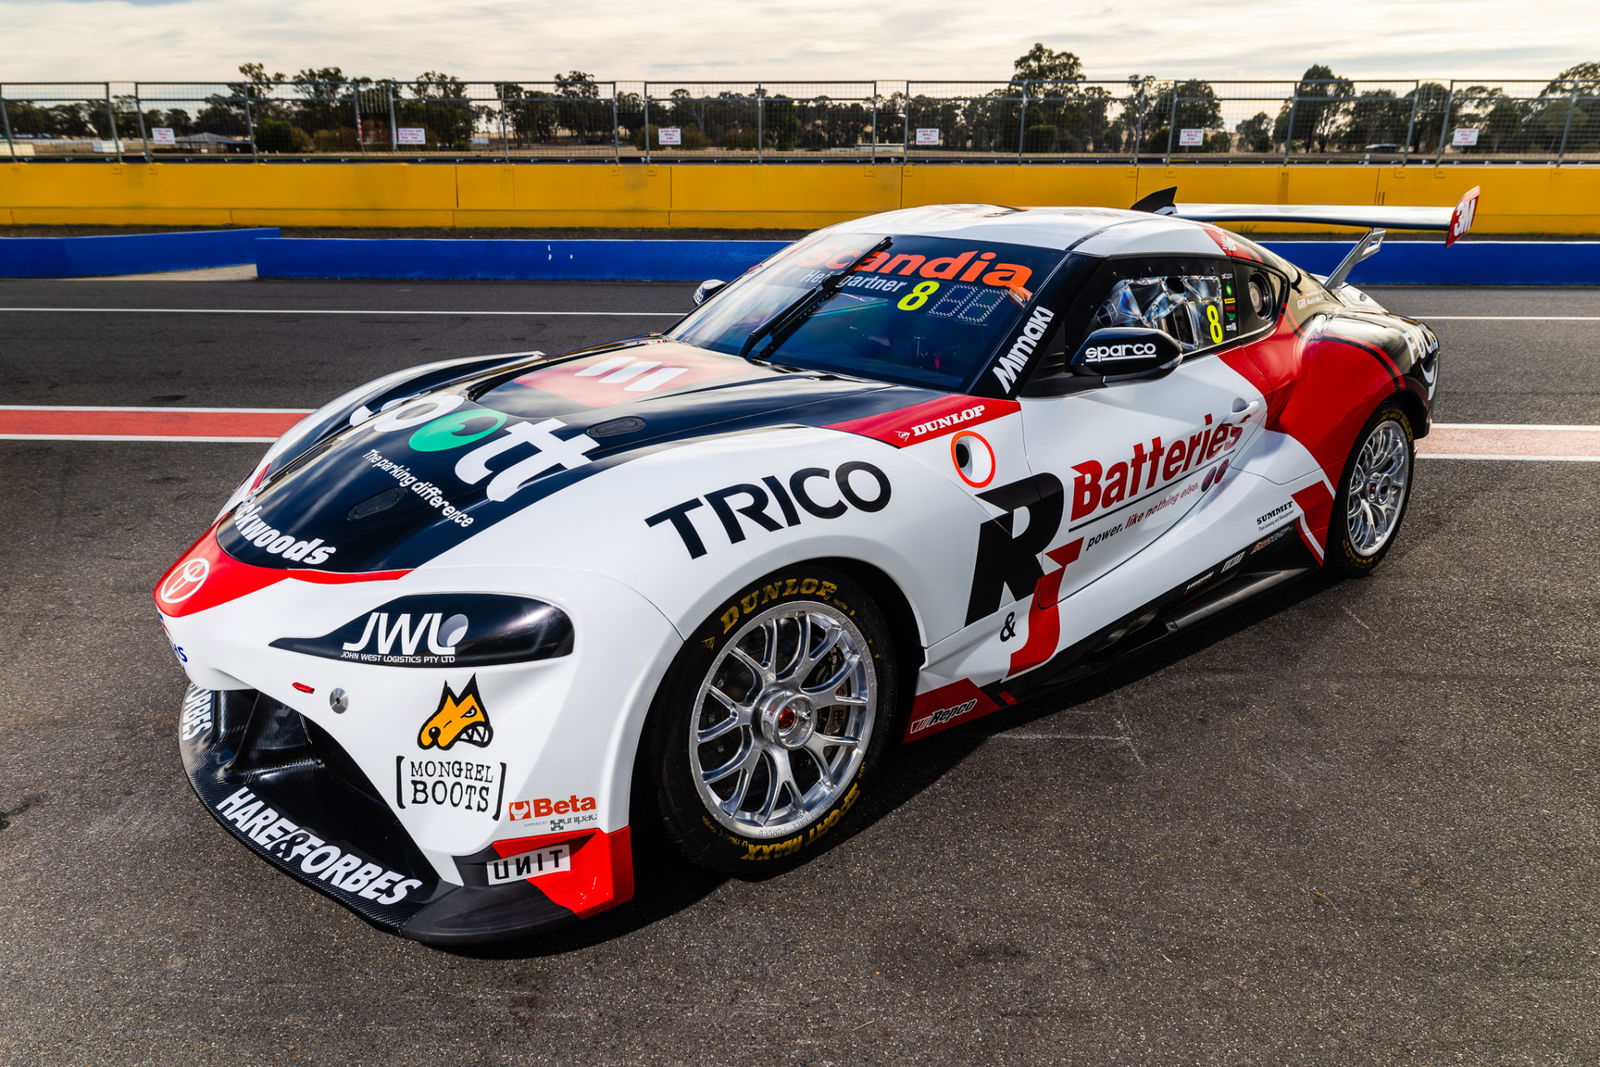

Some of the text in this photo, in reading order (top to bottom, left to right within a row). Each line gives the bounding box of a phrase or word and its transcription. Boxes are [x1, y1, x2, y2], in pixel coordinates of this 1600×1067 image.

[1453, 198, 1476, 237] 3M
[800, 269, 907, 292] Heigartner
[897, 281, 940, 311] 8
[1206, 305, 1223, 344] 8
[1085, 343, 1156, 362] sparco
[911, 405, 985, 437] DUNLOP
[1070, 413, 1254, 521] Batteries
[362, 449, 474, 528] The parking difference
[646, 461, 891, 559] TRICO
[1086, 524, 1123, 550] power.
[1125, 510, 1145, 530] like
[1145, 493, 1178, 521] nothing
[1256, 501, 1293, 526] SUMMIT
[965, 473, 1085, 677] R & J
[720, 577, 838, 635] DUNLOP
[341, 651, 455, 663] JOHN WEST LOGISTICS PTY LTD
[928, 699, 977, 725] Repco
[410, 760, 494, 783] MONGREL
[411, 780, 490, 813] BOOTS
[533, 795, 597, 817] Beta
